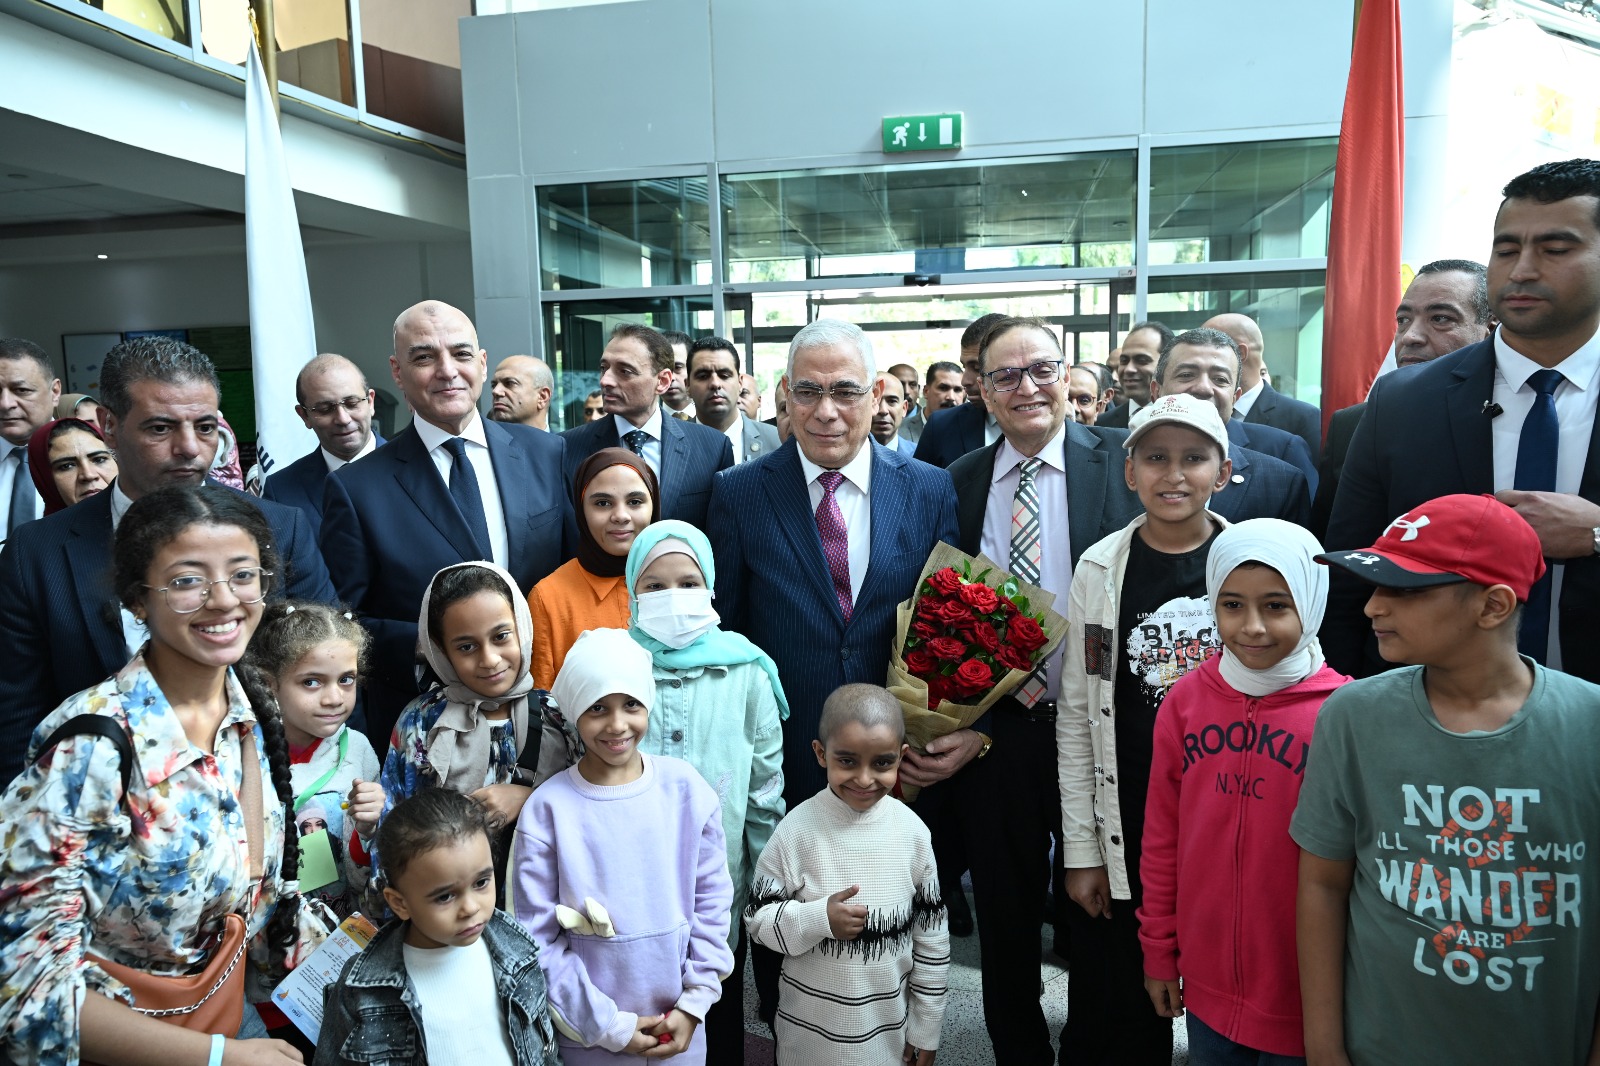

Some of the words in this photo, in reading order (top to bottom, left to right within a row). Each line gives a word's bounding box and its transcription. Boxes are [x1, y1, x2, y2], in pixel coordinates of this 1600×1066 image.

[1137, 611, 1175, 619] LIMITED
[1178, 609, 1203, 618] TIME
[1140, 622, 1219, 649] Blac
[1182, 721, 1310, 776] ROOKLY
[1401, 784, 1541, 833] NOT
[1425, 834, 1515, 862] THOSE
[1525, 841, 1586, 863] WHO
[1375, 858, 1580, 928] WANDER
[1456, 930, 1506, 949] ARE
[1413, 937, 1545, 992] LOST
